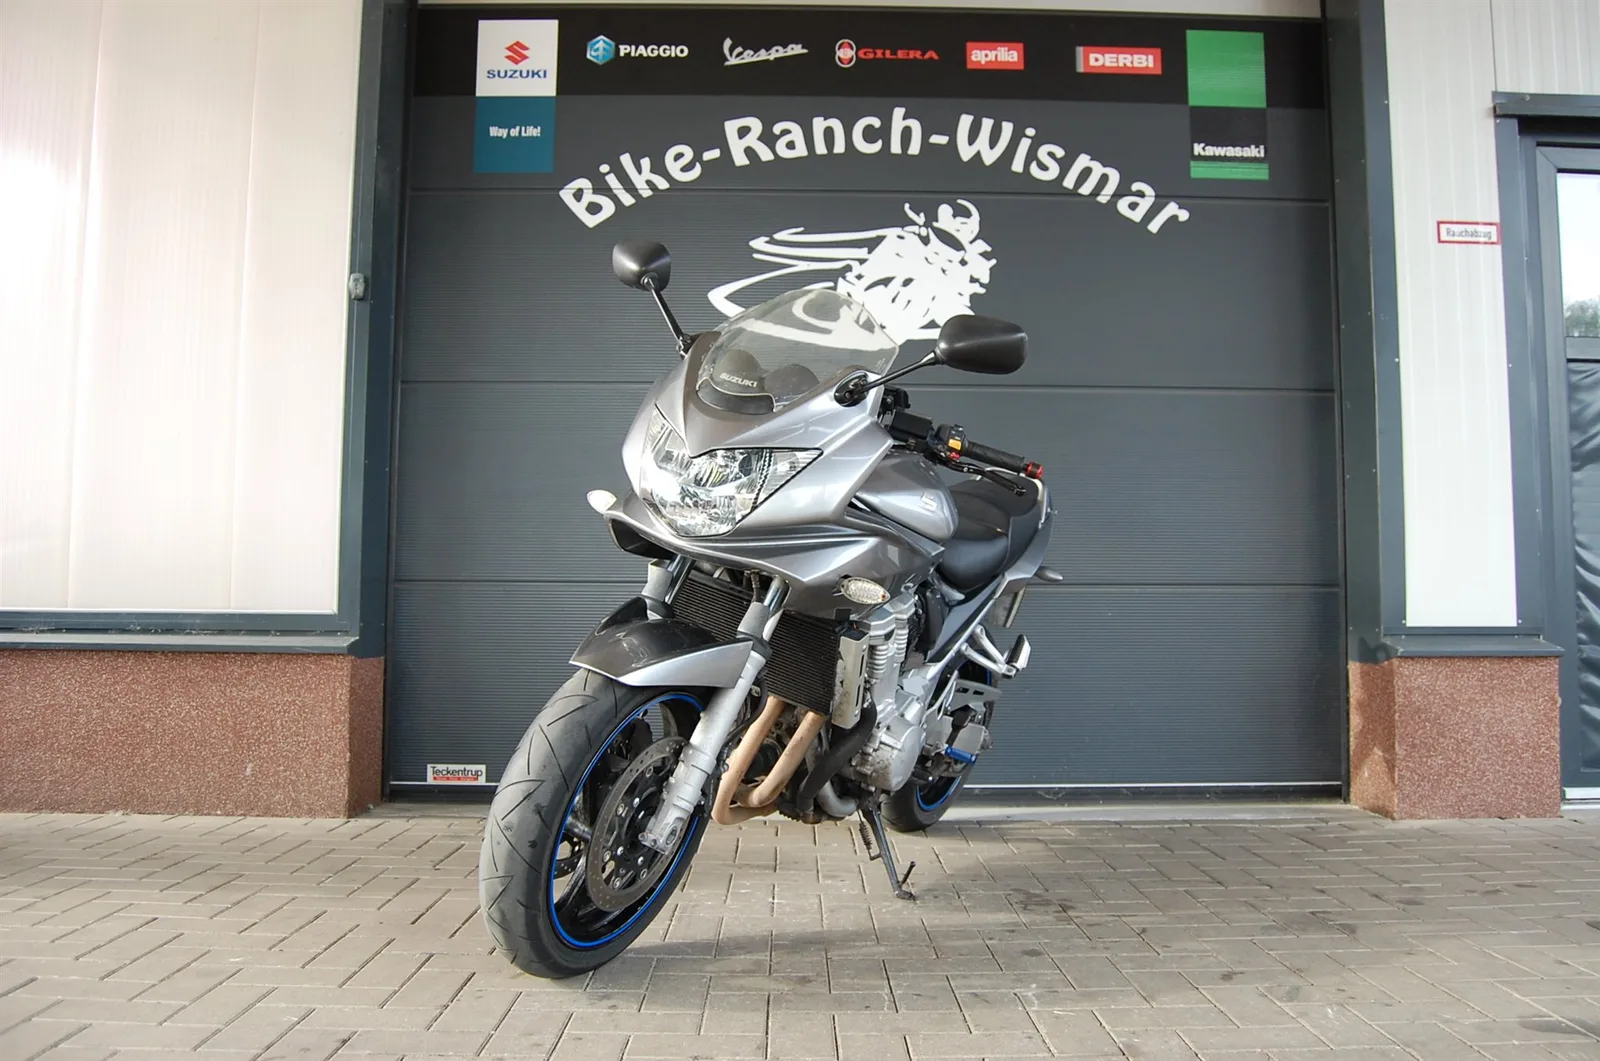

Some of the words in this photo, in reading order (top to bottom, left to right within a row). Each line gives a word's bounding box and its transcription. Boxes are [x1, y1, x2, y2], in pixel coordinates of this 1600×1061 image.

[618, 44, 689, 58] PIAGGIO
[722, 37, 809, 66] Vespa
[857, 48, 940, 60] GILERA
[970, 47, 1018, 64] aprilia
[1088, 52, 1155, 68] DERBI
[486, 69, 547, 79] SUZUKI
[489, 126, 508, 138] Way
[509, 126, 520, 137] of
[521, 126, 541, 137] Life!
[1193, 142, 1266, 159] Kawasaki
[559, 107, 1190, 234] Bike-Ranch-Wismar
[719, 372, 758, 387] SUZUKI
[430, 766, 483, 781] Teckentrup
